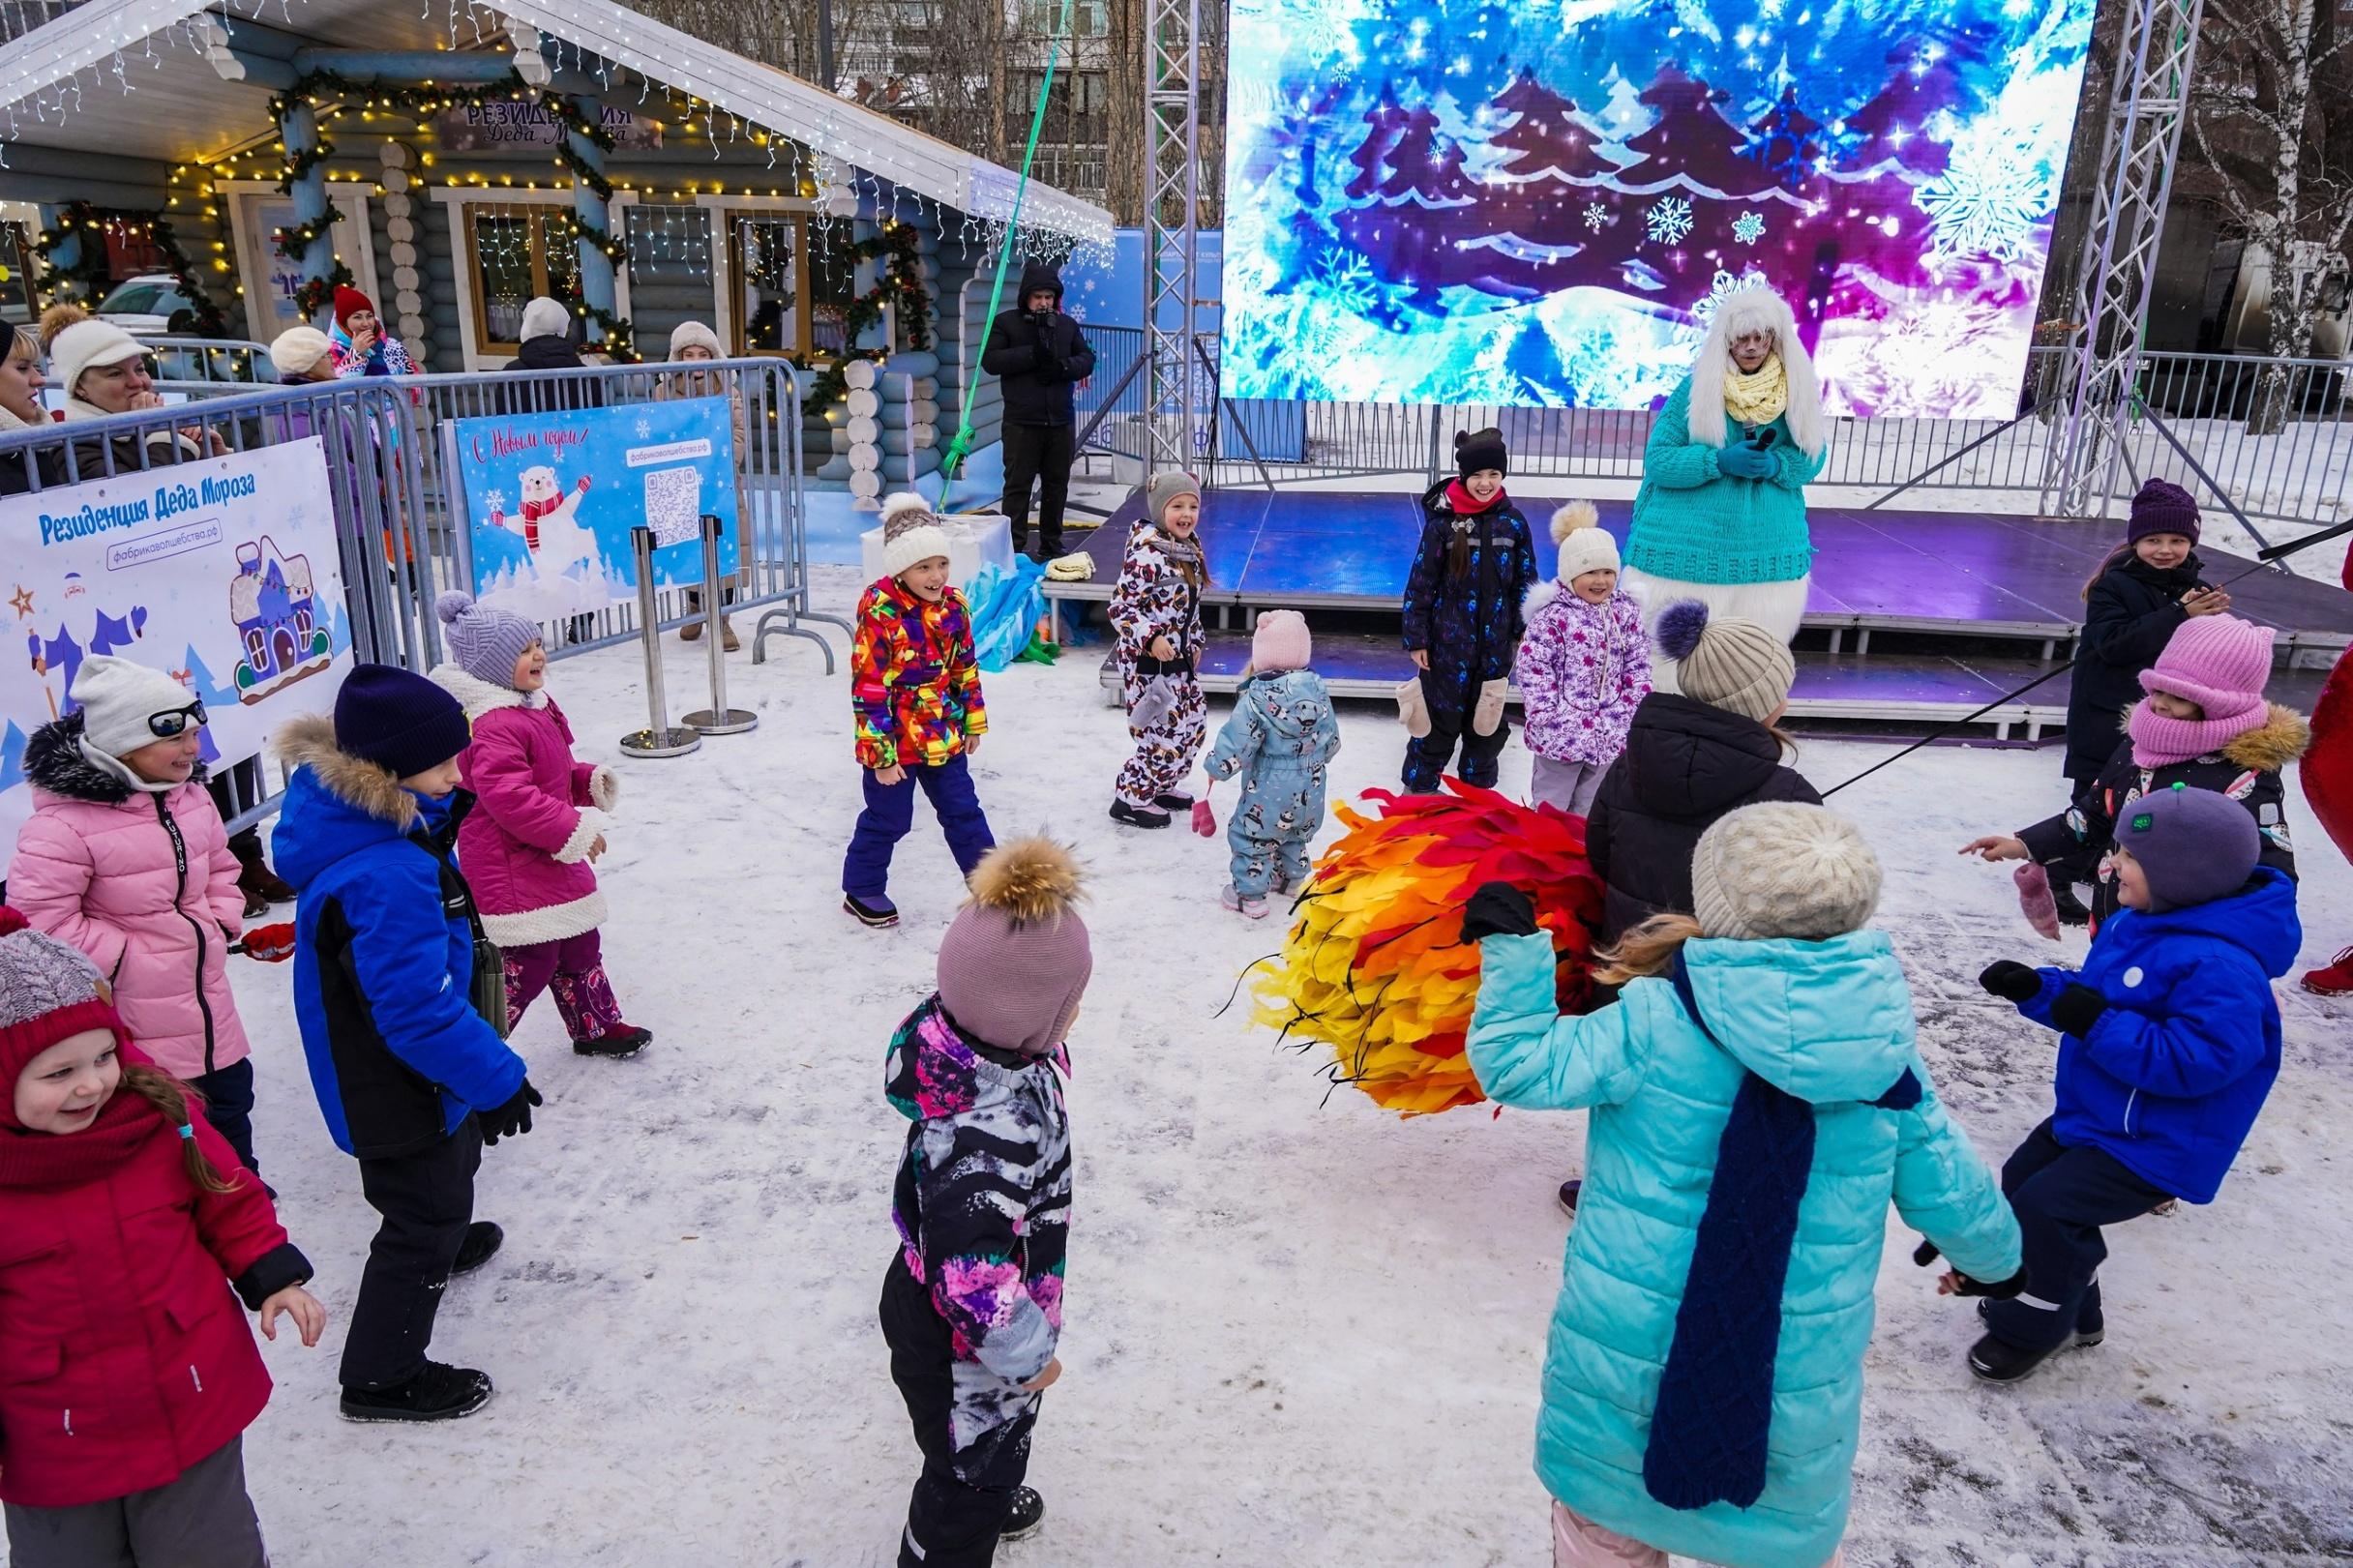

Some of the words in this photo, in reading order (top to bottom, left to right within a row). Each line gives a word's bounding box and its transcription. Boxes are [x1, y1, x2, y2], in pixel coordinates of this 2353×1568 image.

[465, 101, 633, 126] РЕЗИДЕИЯ
[484, 122, 537, 141] Деда
[472, 434, 487, 464] С
[491, 425, 538, 458] Новым
[544, 428, 589, 459] годом!
[39, 498, 149, 547] Резиденция
[155, 484, 198, 521] Деда
[200, 473, 255, 507] Мороза
[164, 818, 185, 872] FUTURINO
